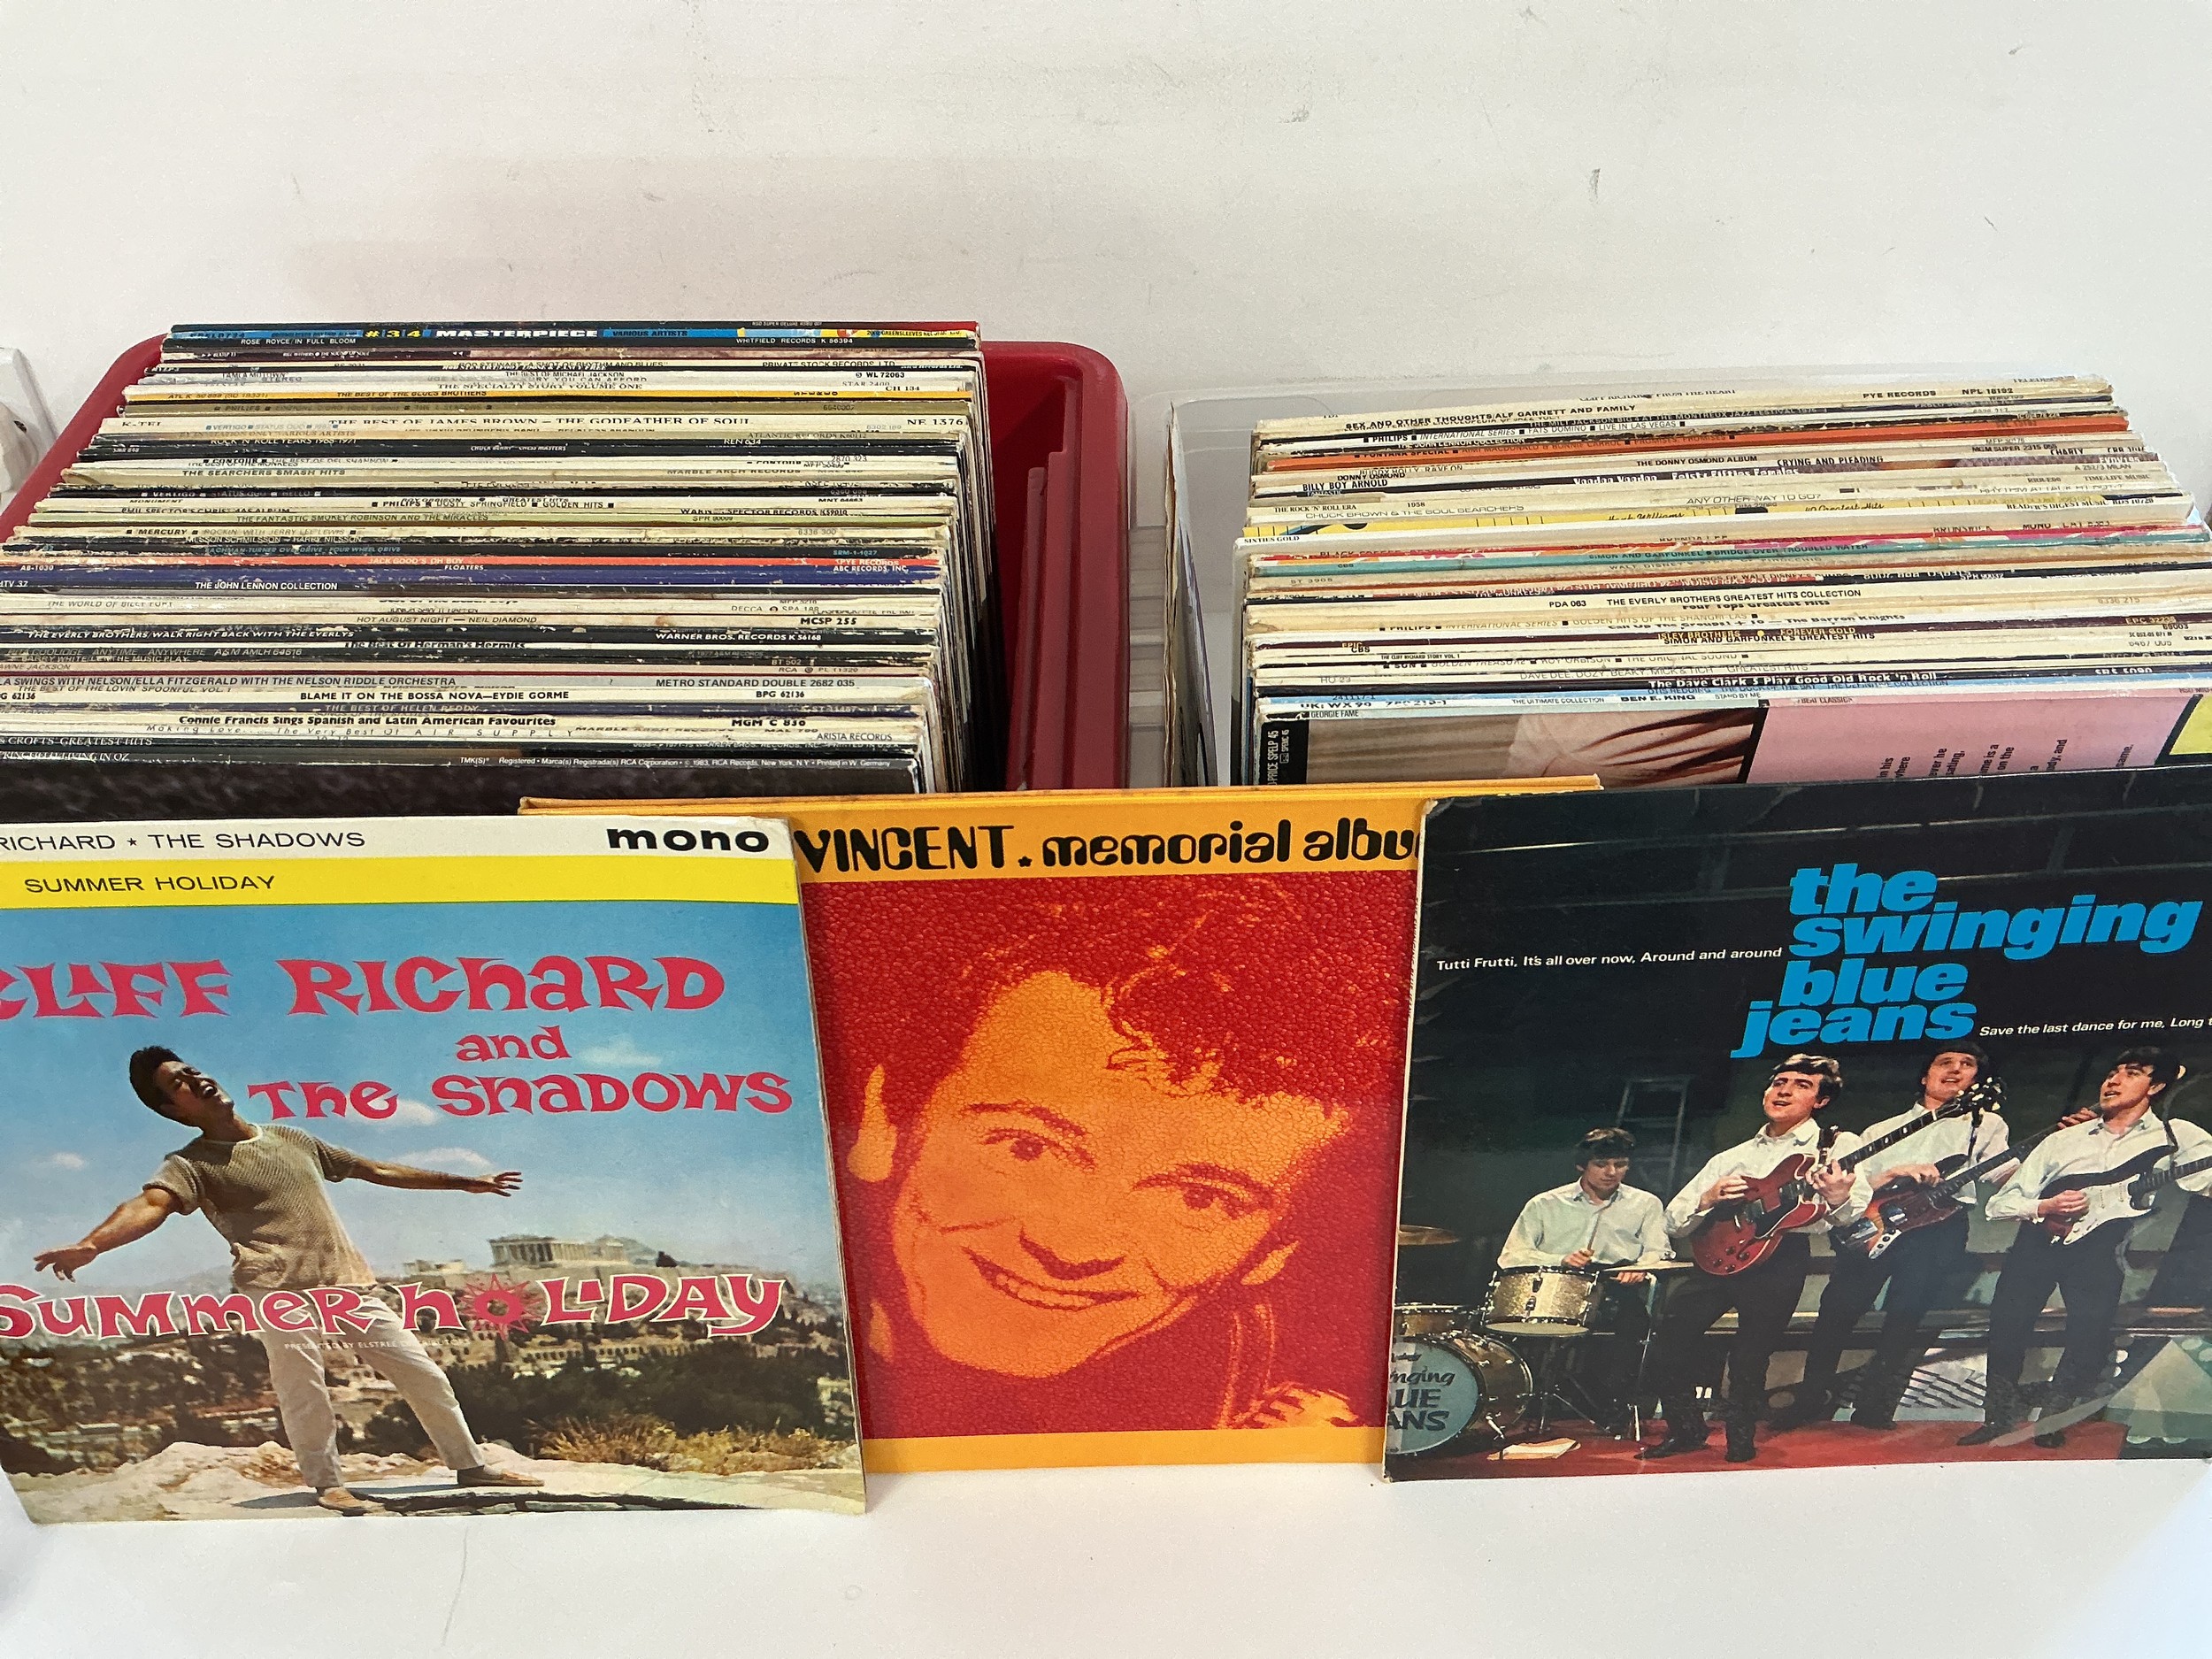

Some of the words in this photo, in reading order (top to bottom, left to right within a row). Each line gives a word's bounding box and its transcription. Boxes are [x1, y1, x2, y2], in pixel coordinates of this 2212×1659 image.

[1517, 409, 1566, 417] GARNETT
[1420, 430, 1486, 440] INTERNATIONAL
[1352, 480, 1387, 488] ARNOLD
[1724, 593, 1773, 601] GREATEST
[14, 677, 55, 685] SWINGS
[58, 677, 86, 685] WITH
[167, 677, 238, 685] FITZGERALD
[241, 677, 271, 685] WITH
[273, 677, 294, 685] THE
[297, 677, 340, 685] NELSON
[656, 679, 695, 687] METRO
[698, 679, 760, 687] STANDARD
[762, 679, 807, 687] DOUBLE
[1712, 678, 1747, 686] Clark
[1763, 676, 1790, 686] Play
[1795, 675, 1828, 684] Good
[1832, 674, 1855, 683] Old
[1859, 673, 1891, 681] Rock
[1912, 672, 1936, 680] Roll
[179, 716, 220, 725] Connie
[225, 716, 269, 725] Francis
[307, 716, 354, 726] Spanish
[358, 717, 380, 725] and
[386, 717, 418, 725] Latin
[421, 717, 484, 725] American
[488, 717, 556, 726] Favourites
[148, 833, 204, 849] THE
[216, 832, 365, 848] SHADOWS
[606, 826, 770, 854] mono
[1042, 819, 1291, 867] memorial
[1302, 818, 1421, 863] albu
[25, 876, 144, 894] SUMMER
[155, 875, 276, 891] HOLIDAY
[1789, 863, 1938, 915] the
[1788, 895, 2203, 961] swinging
[1437, 959, 1471, 971] Tutti
[1474, 957, 1517, 968] Frutti,
[1546, 955, 1563, 964] all
[1566, 956, 1597, 965] over
[1601, 956, 1635, 965] now,
[1640, 950, 1695, 963] Around
[1699, 949, 1726, 960] and
[1730, 947, 1782, 959] around
[1778, 957, 1969, 1006] blue
[1730, 1000, 1978, 1058] jeans
[1978, 1026, 2014, 1036] Save
[2017, 1025, 2040, 1034] the
[2042, 1023, 2069, 1033] last
[2072, 1021, 2115, 1032] dance
[2117, 1019, 2138, 1030] for
[2140, 1019, 2166, 1029] me,
[2170, 1018, 2205, 1029] Long
[455, 1025, 572, 1062] and
[248, 1079, 400, 1120] The
